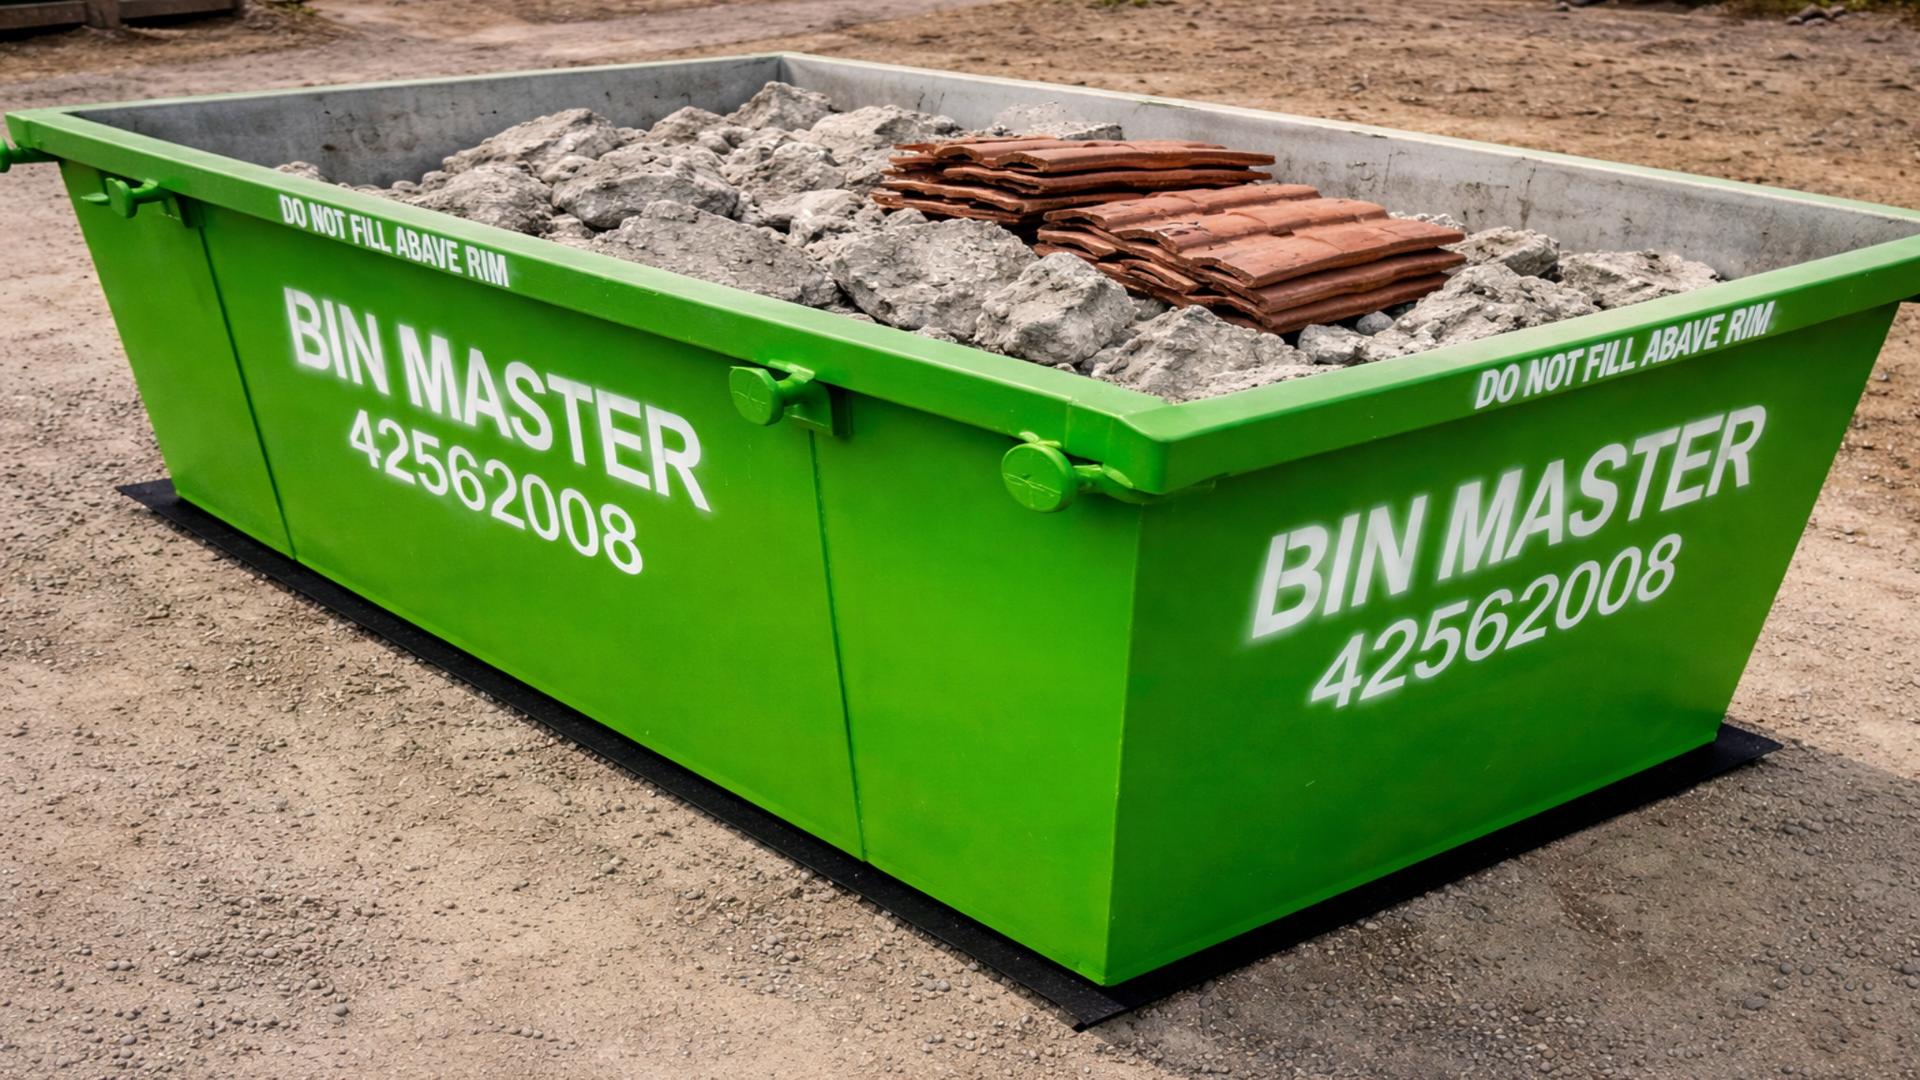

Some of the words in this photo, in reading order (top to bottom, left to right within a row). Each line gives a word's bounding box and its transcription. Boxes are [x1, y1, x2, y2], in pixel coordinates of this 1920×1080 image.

[279, 193, 307, 228] DO
[309, 202, 346, 239] NOT
[350, 214, 392, 254] FILL
[396, 226, 462, 273] ABAVE
[465, 245, 510, 287] RIM
[284, 287, 389, 396] BIN
[398, 324, 711, 512] MASTER
[1474, 363, 1520, 409] DO
[1523, 348, 1584, 397] NOT
[1582, 337, 1636, 382] FILL
[1640, 313, 1725, 366] ABAVE
[1724, 300, 1775, 344] RIM
[350, 409, 643, 575] 42562008
[1251, 495, 1427, 639] BIN
[1437, 405, 1766, 581] MASTER
[1310, 533, 1682, 709] 42562008
